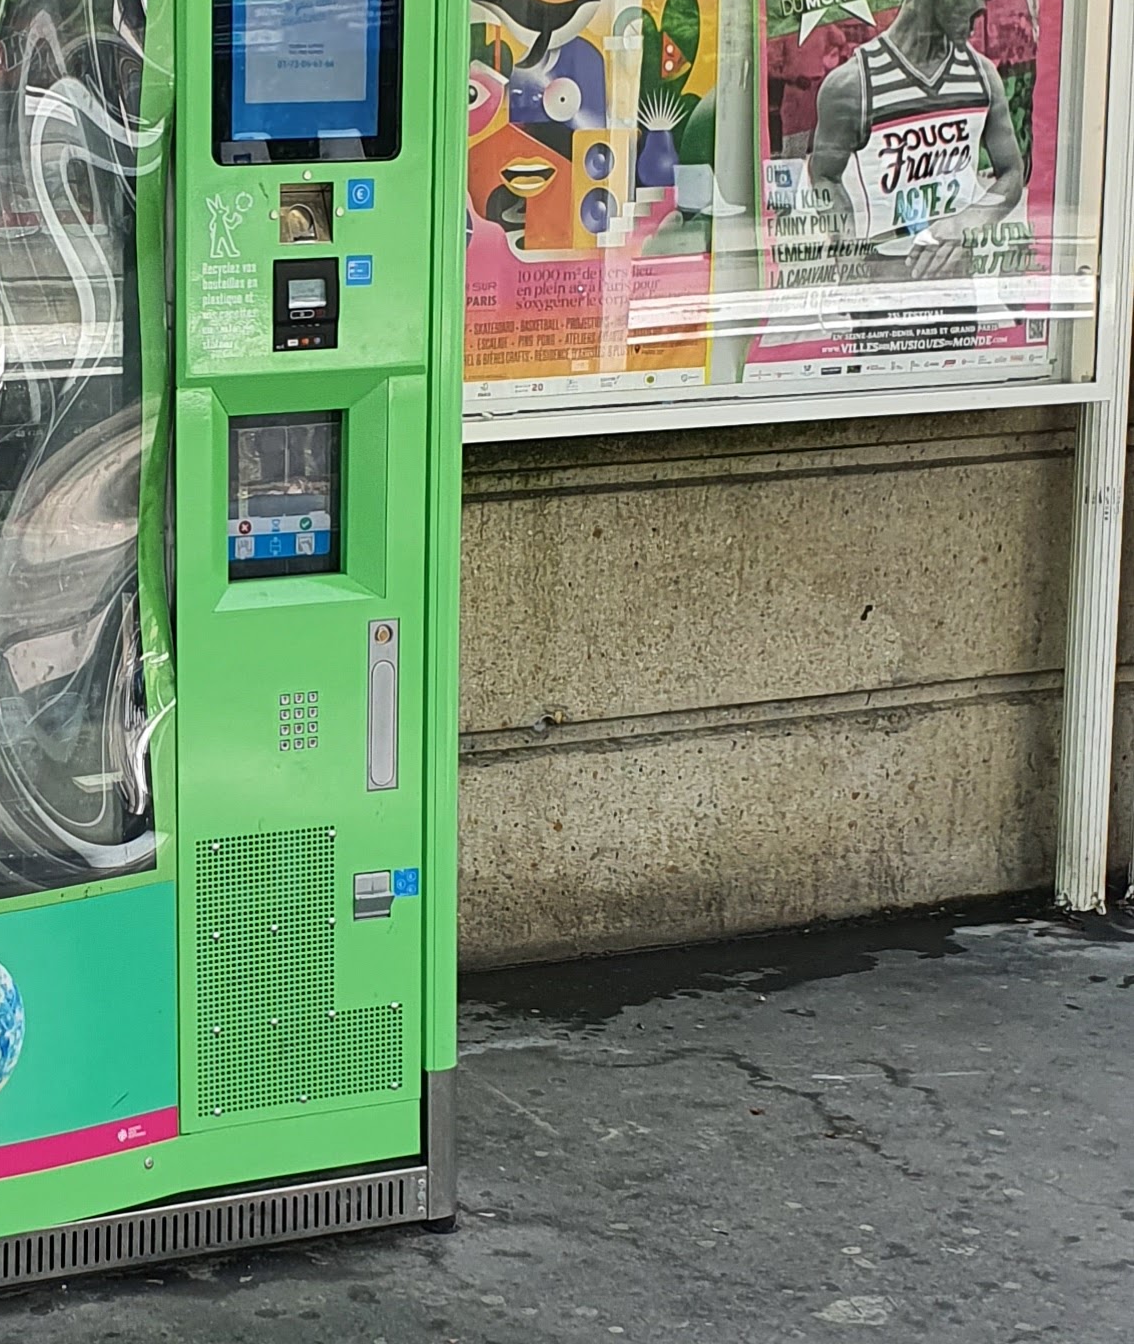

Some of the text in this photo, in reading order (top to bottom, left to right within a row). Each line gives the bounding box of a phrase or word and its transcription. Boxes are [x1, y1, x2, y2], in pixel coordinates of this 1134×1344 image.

[882, 118, 970, 151] DOUCE
[878, 144, 972, 195] France
[892, 179, 960, 226] ACTE 2
[767, 215, 808, 238] FANNY
[582, 266, 597, 280] de
[771, 270, 785, 289] LA
[472, 281, 498, 292] SUR
[517, 287, 532, 297] en
[534, 282, 566, 298] plein
[467, 295, 497, 307] PARIS
